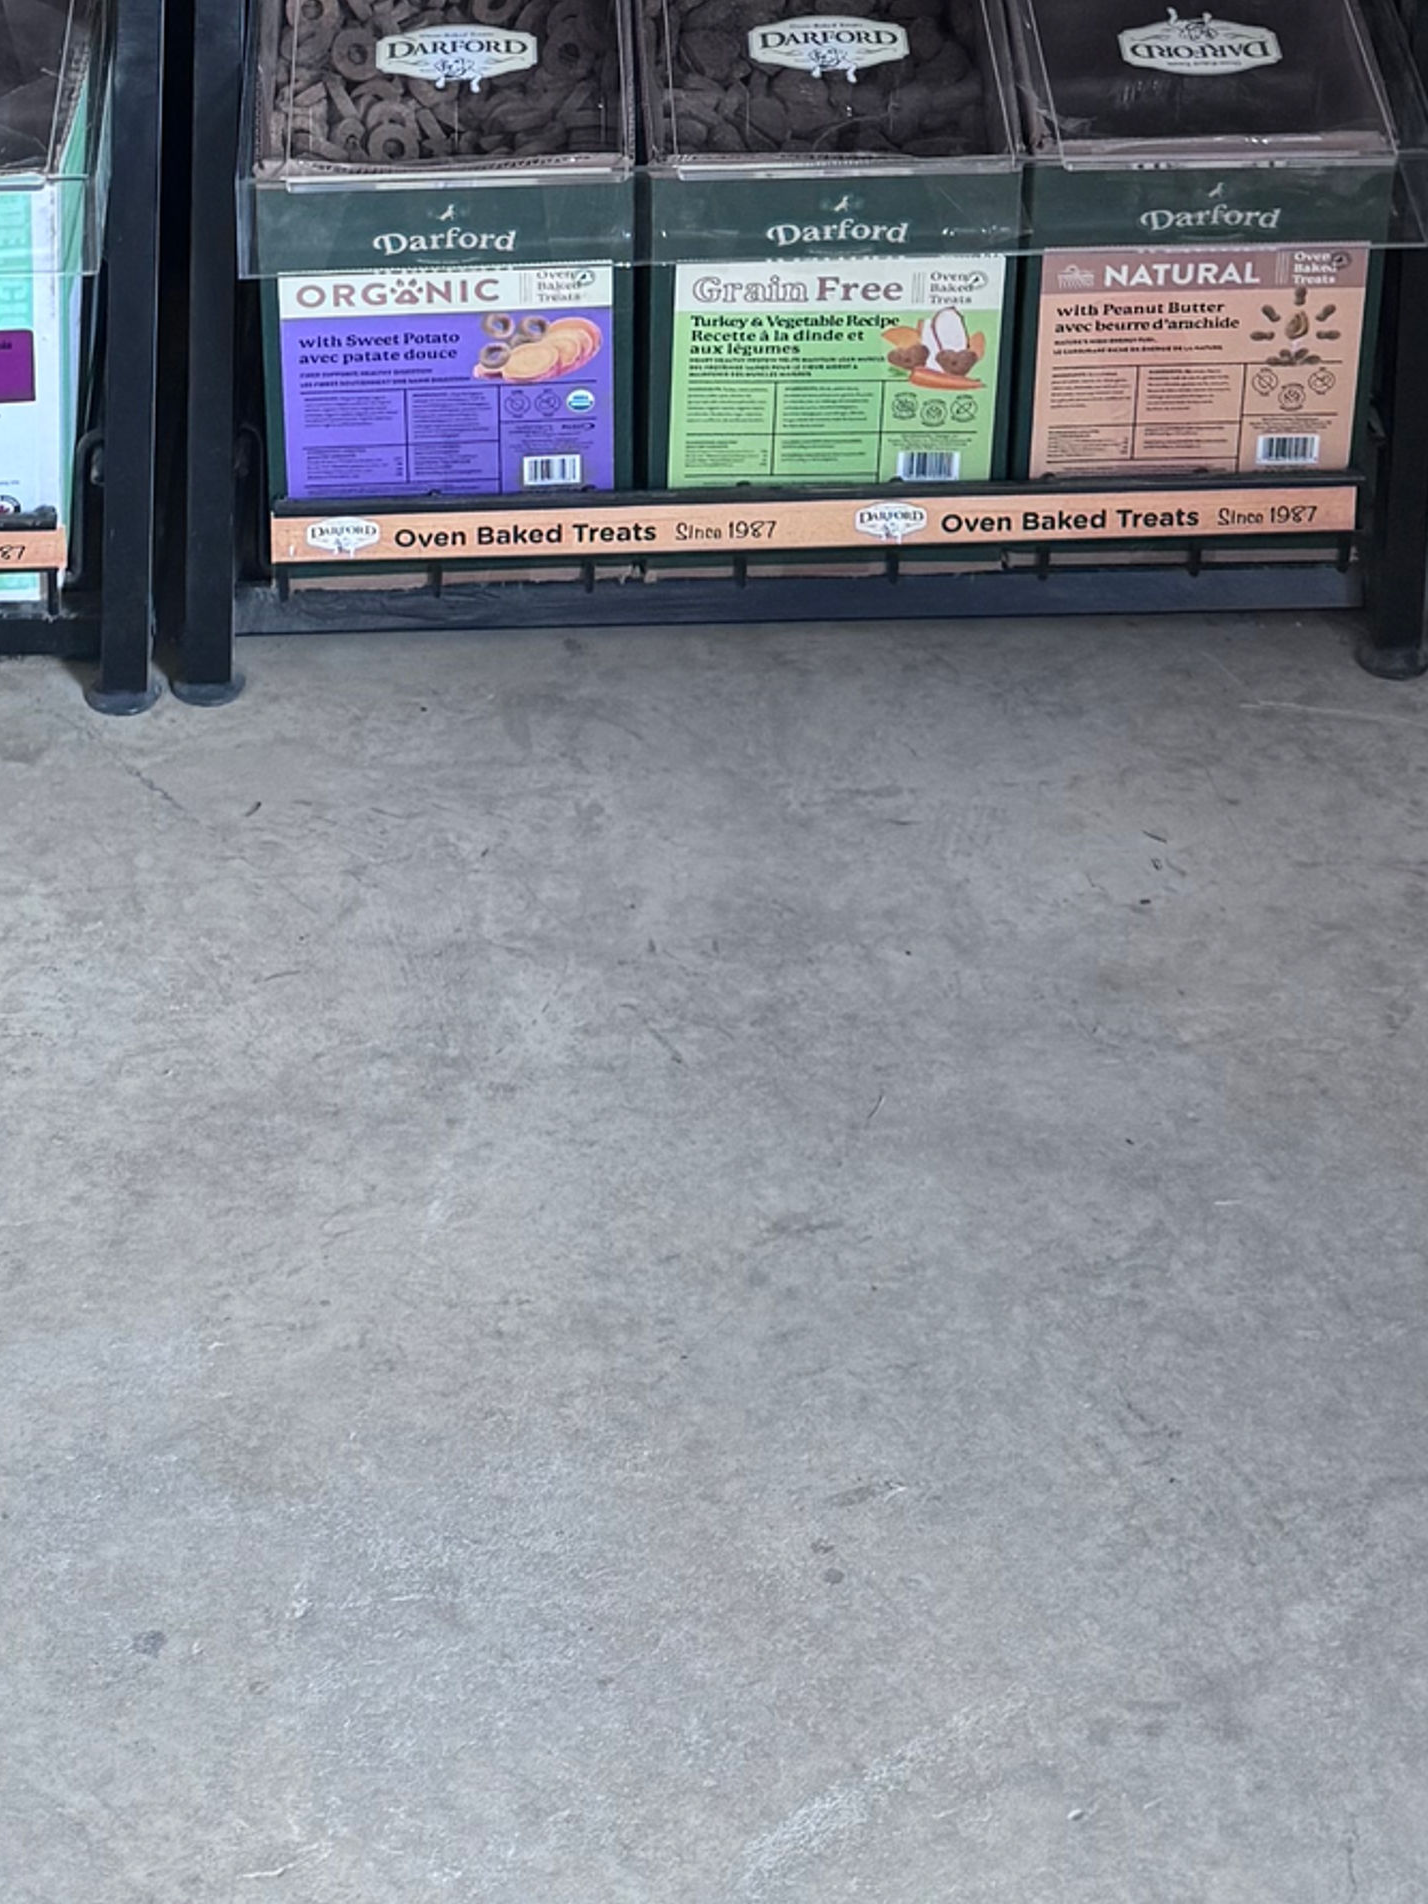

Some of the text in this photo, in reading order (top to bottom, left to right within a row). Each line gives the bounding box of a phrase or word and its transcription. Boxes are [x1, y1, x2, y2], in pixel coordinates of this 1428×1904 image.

[373, 227, 516, 255] Darford
[1104, 262, 1260, 287] NATURAL
[299, 332, 459, 349] with Sweet Potato
[395, 520, 777, 548] Oven Baked Treats Since 1987
